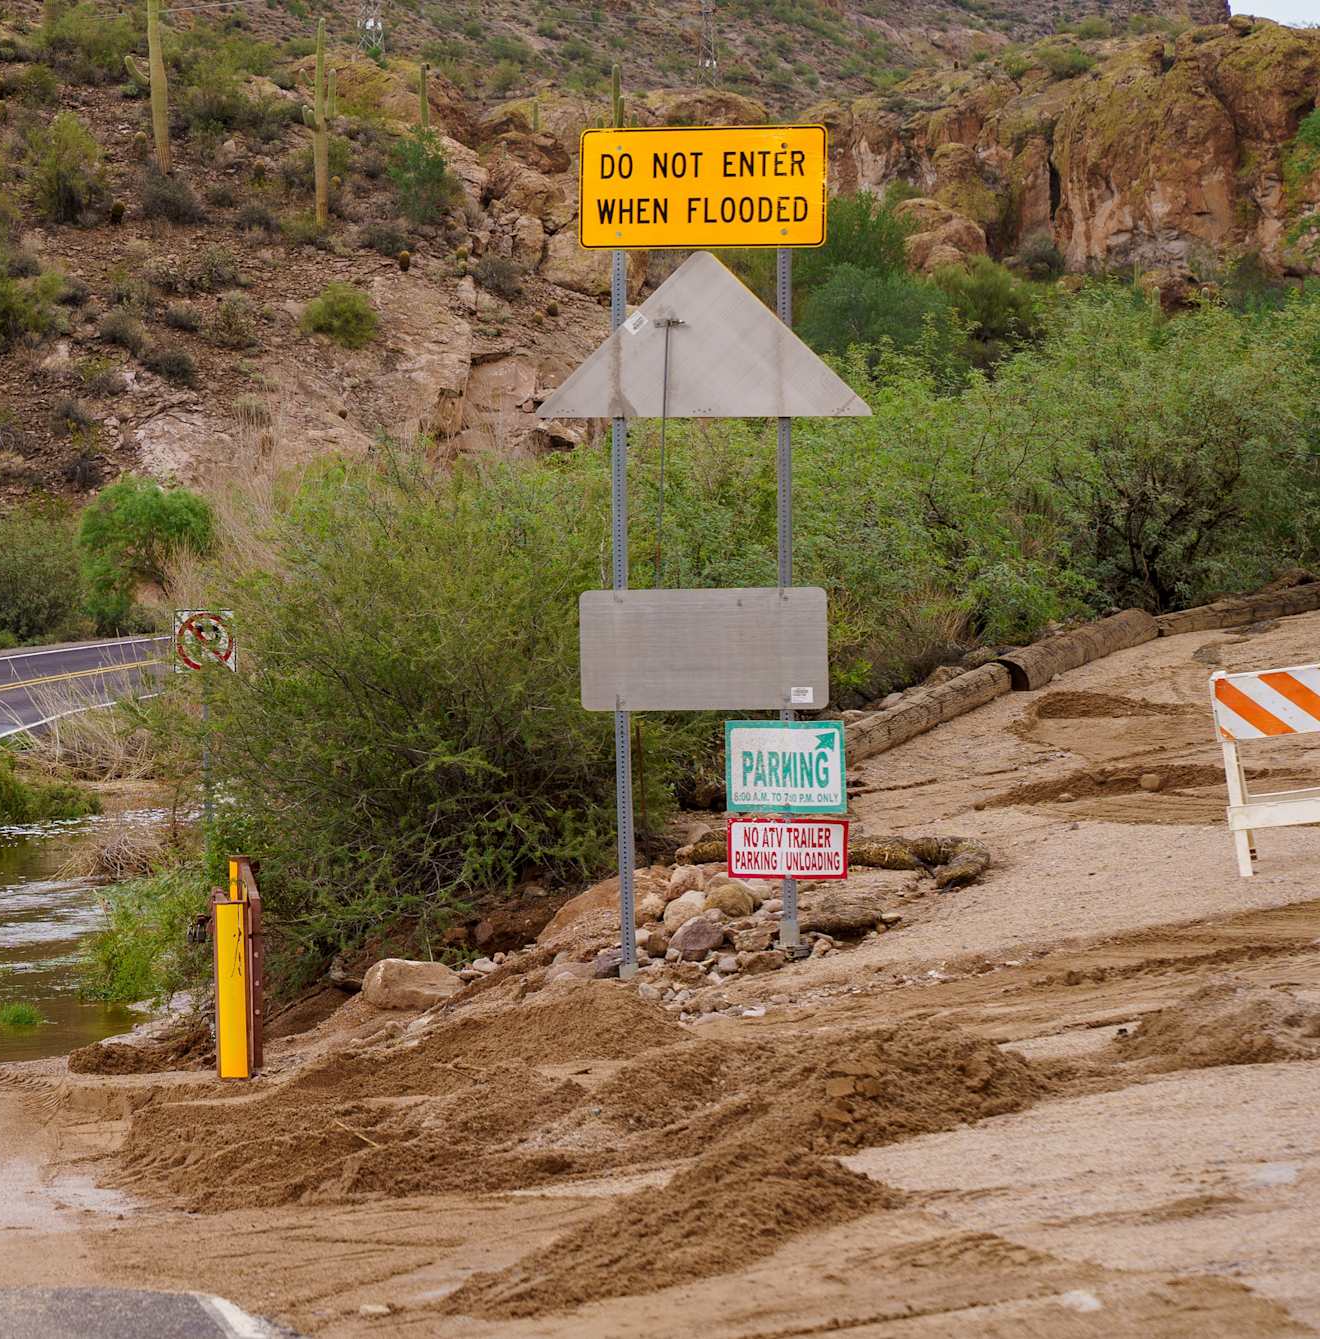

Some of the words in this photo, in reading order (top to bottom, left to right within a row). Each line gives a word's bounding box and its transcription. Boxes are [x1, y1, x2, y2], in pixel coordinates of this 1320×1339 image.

[600, 153, 634, 179] DO
[653, 151, 703, 179] NOT
[723, 150, 805, 178] ENTER
[597, 198, 668, 225] WHEN
[687, 196, 809, 224] FLOODED
[742, 750, 830, 789] PARKING
[772, 792, 782, 802] TO
[817, 793, 839, 803] ONLY
[743, 826, 759, 848] NO
[762, 827, 783, 848] ATV
[786, 827, 832, 848] TRAILER
[735, 850, 777, 870] PARKING
[785, 851, 841, 871] UNLOADING
